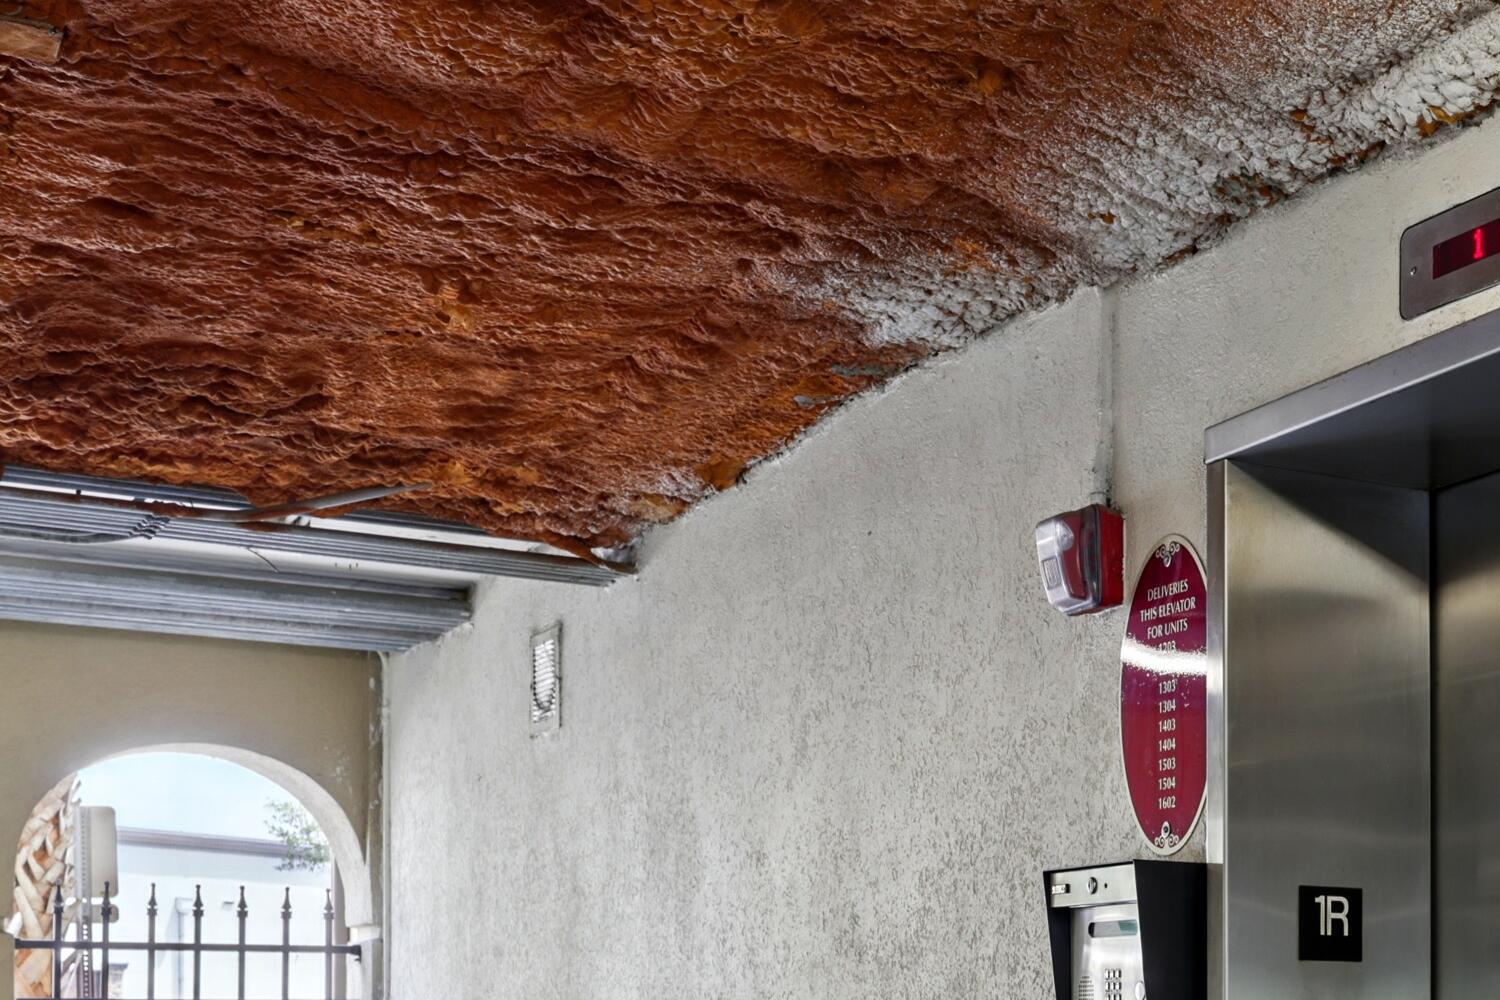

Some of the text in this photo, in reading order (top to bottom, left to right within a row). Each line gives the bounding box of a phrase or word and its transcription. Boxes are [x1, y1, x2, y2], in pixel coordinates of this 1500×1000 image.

[1473, 228, 1484, 260] 1
[1147, 578, 1189, 602] DELIVERIES
[1140, 596, 1196, 622] THIS ELEVATOR
[1147, 617, 1188, 640] FOR UNITS
[1158, 679, 1176, 694] 1303
[1158, 699, 1176, 713] 1304
[1158, 718, 1176, 732] 1403
[1158, 738, 1176, 752] 1404
[1158, 758, 1176, 771] 1503
[1158, 777, 1176, 790] 1504
[1158, 796, 1176, 810] 1602
[1314, 894, 1349, 937] 1R
